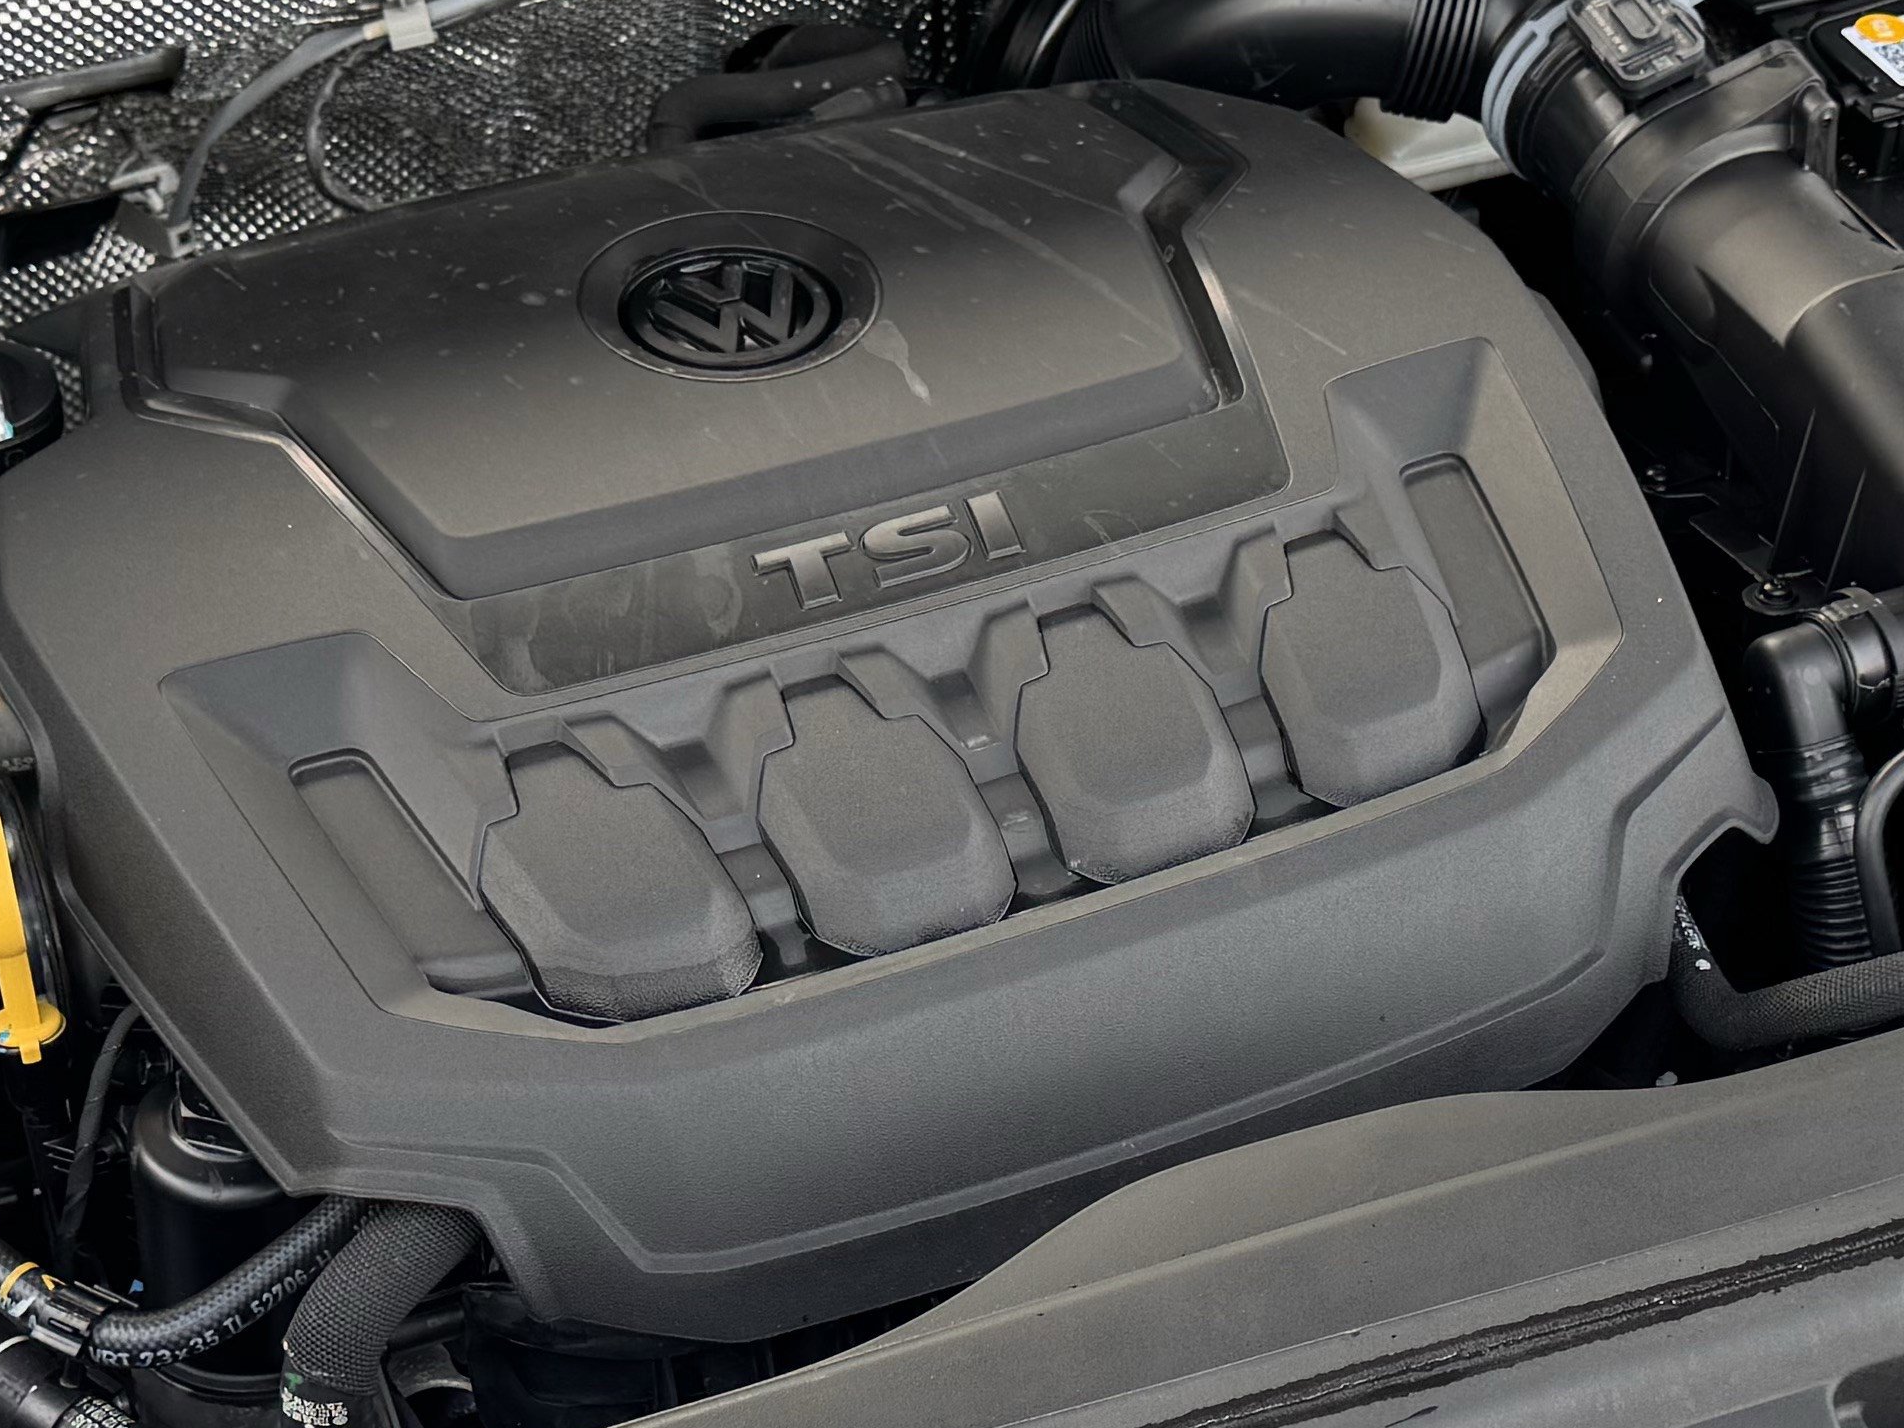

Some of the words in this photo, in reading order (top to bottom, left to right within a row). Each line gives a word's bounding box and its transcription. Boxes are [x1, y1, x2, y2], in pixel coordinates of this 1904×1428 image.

[634, 254, 831, 364] VW
[750, 491, 1026, 613] TSI
[89, 1345, 131, 1369] VRT
[222, 1311, 248, 1335] TL
